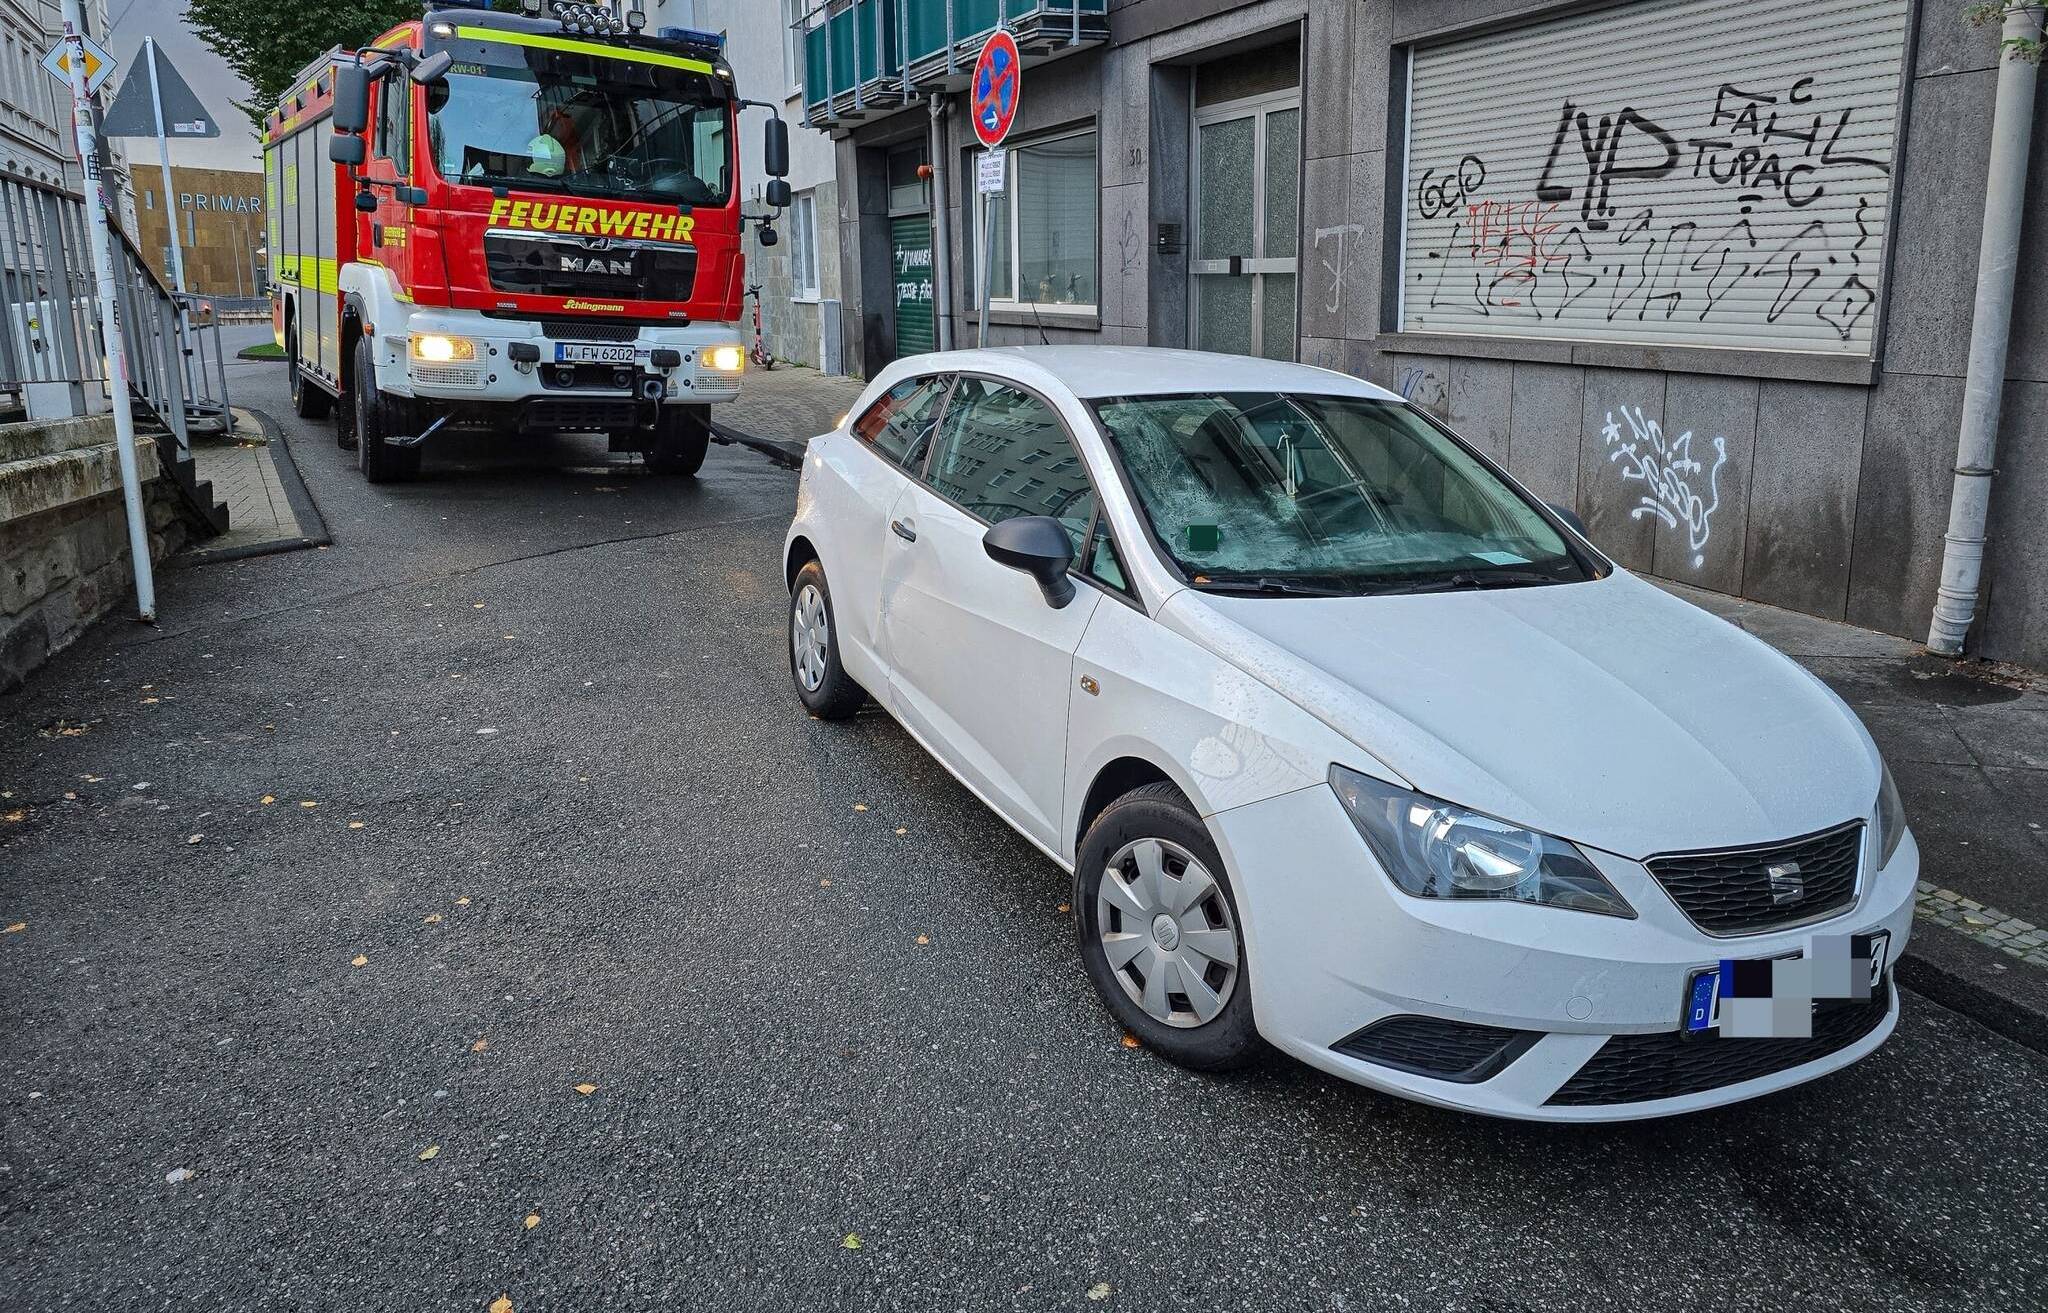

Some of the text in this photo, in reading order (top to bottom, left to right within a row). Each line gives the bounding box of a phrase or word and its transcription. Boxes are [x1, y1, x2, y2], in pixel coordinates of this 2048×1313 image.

[1130, 148, 1142, 166] 30
[1687, 137, 1824, 208] TUPAC
[488, 199, 696, 242] FEUERWEHR
[560, 256, 632, 277] MAN
[562, 299, 624, 312] Schlingmann
[565, 346, 574, 359] W
[582, 347, 599, 360] FW
[602, 347, 633, 361] 6202
